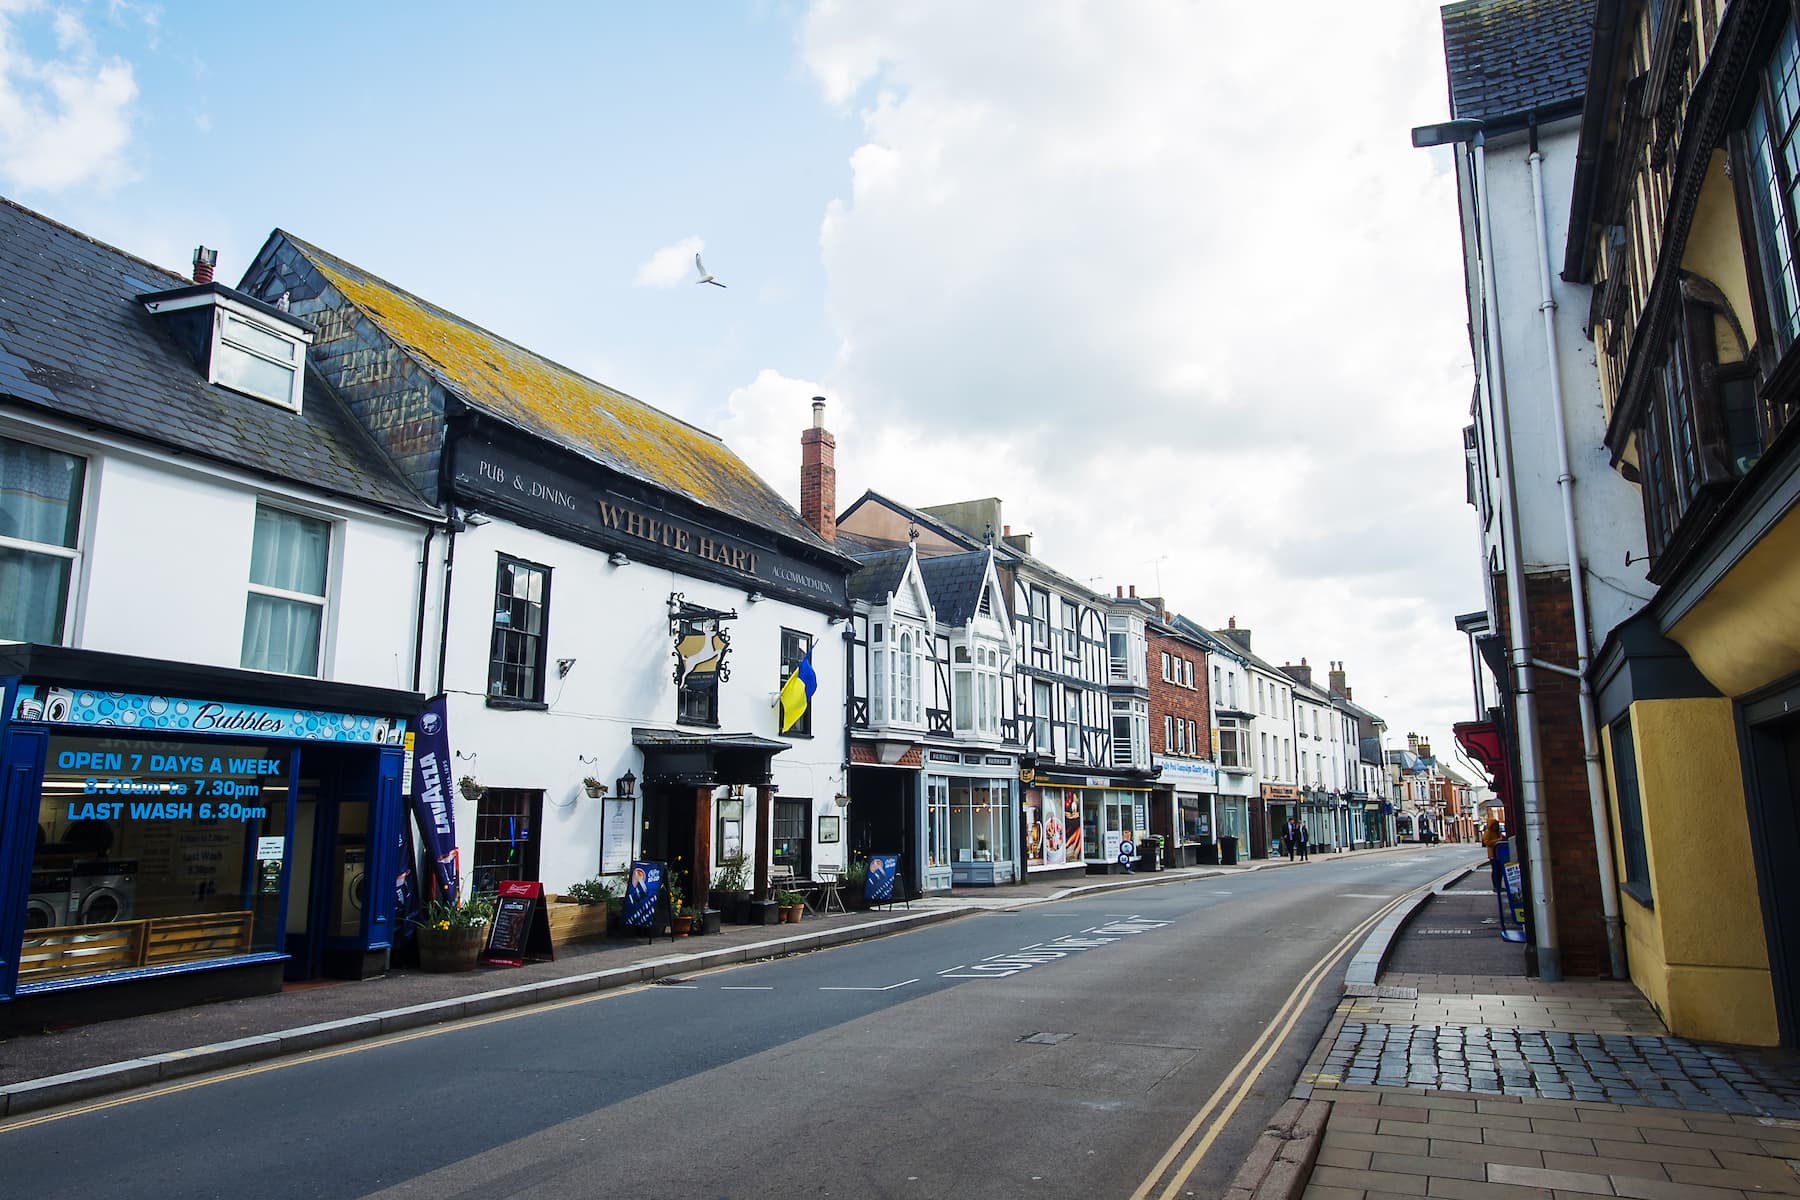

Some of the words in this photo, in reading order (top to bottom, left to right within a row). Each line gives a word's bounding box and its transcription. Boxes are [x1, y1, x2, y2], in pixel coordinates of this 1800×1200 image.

[480, 460, 504, 483] PUB
[513, 475, 524, 491] &
[532, 482, 576, 510] DINING
[598, 500, 690, 553] WHITE
[700, 534, 760, 574] HART
[772, 566, 833, 594] ACCOMMODATION
[192, 702, 284, 732] Bubbles
[58, 752, 122, 770] OPEN
[130, 754, 143, 771] 7
[150, 755, 203, 773] DAYS
[208, 757, 222, 774] A
[228, 759, 280, 776] WEEK
[84, 778, 161, 796] 8.30am
[168, 780, 188, 796] to
[194, 780, 259, 799] 7.30pm
[420, 752, 450, 834] LAVAZZA
[67, 802, 124, 820] LAST
[130, 803, 192, 820] WASH
[198, 802, 266, 822] 6.30pm
[942, 937, 1121, 977] LOADING
